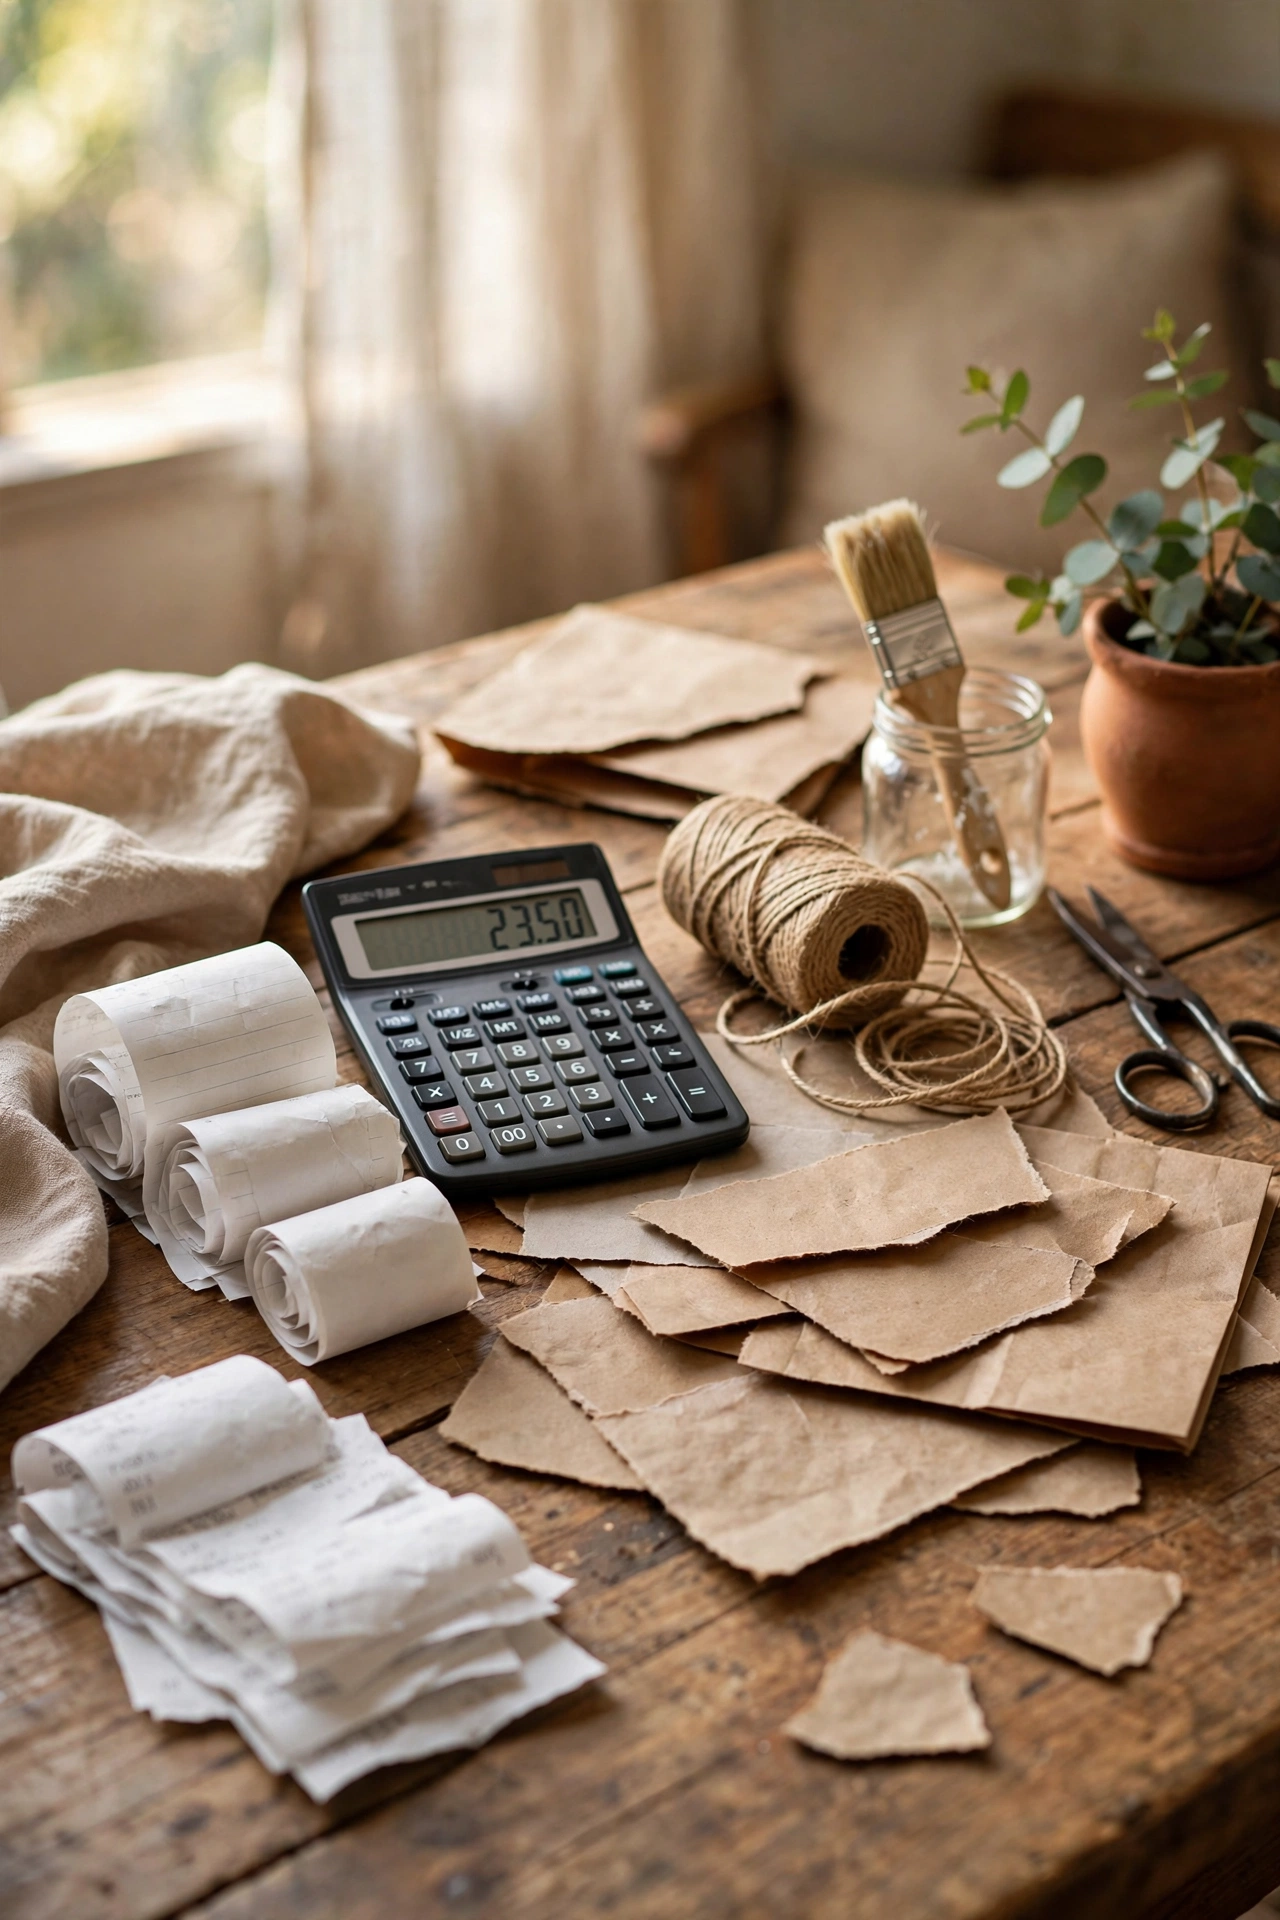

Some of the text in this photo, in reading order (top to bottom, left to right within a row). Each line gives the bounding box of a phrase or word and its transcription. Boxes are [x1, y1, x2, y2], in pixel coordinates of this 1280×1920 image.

[487, 897, 584, 949] 23.50
[511, 1044, 527, 1057] 8
[556, 1038, 571, 1050] 9
[465, 1052, 478, 1065] 7
[414, 1061, 427, 1073] 7
[570, 1062, 586, 1074] 6
[525, 1069, 540, 1082] 5
[480, 1077, 495, 1089] 4
[584, 1087, 600, 1100] 3
[539, 1095, 555, 1108] 2
[494, 1102, 505, 1115] 1
[501, 1127, 527, 1142] 00
[455, 1137, 470, 1150] 0
